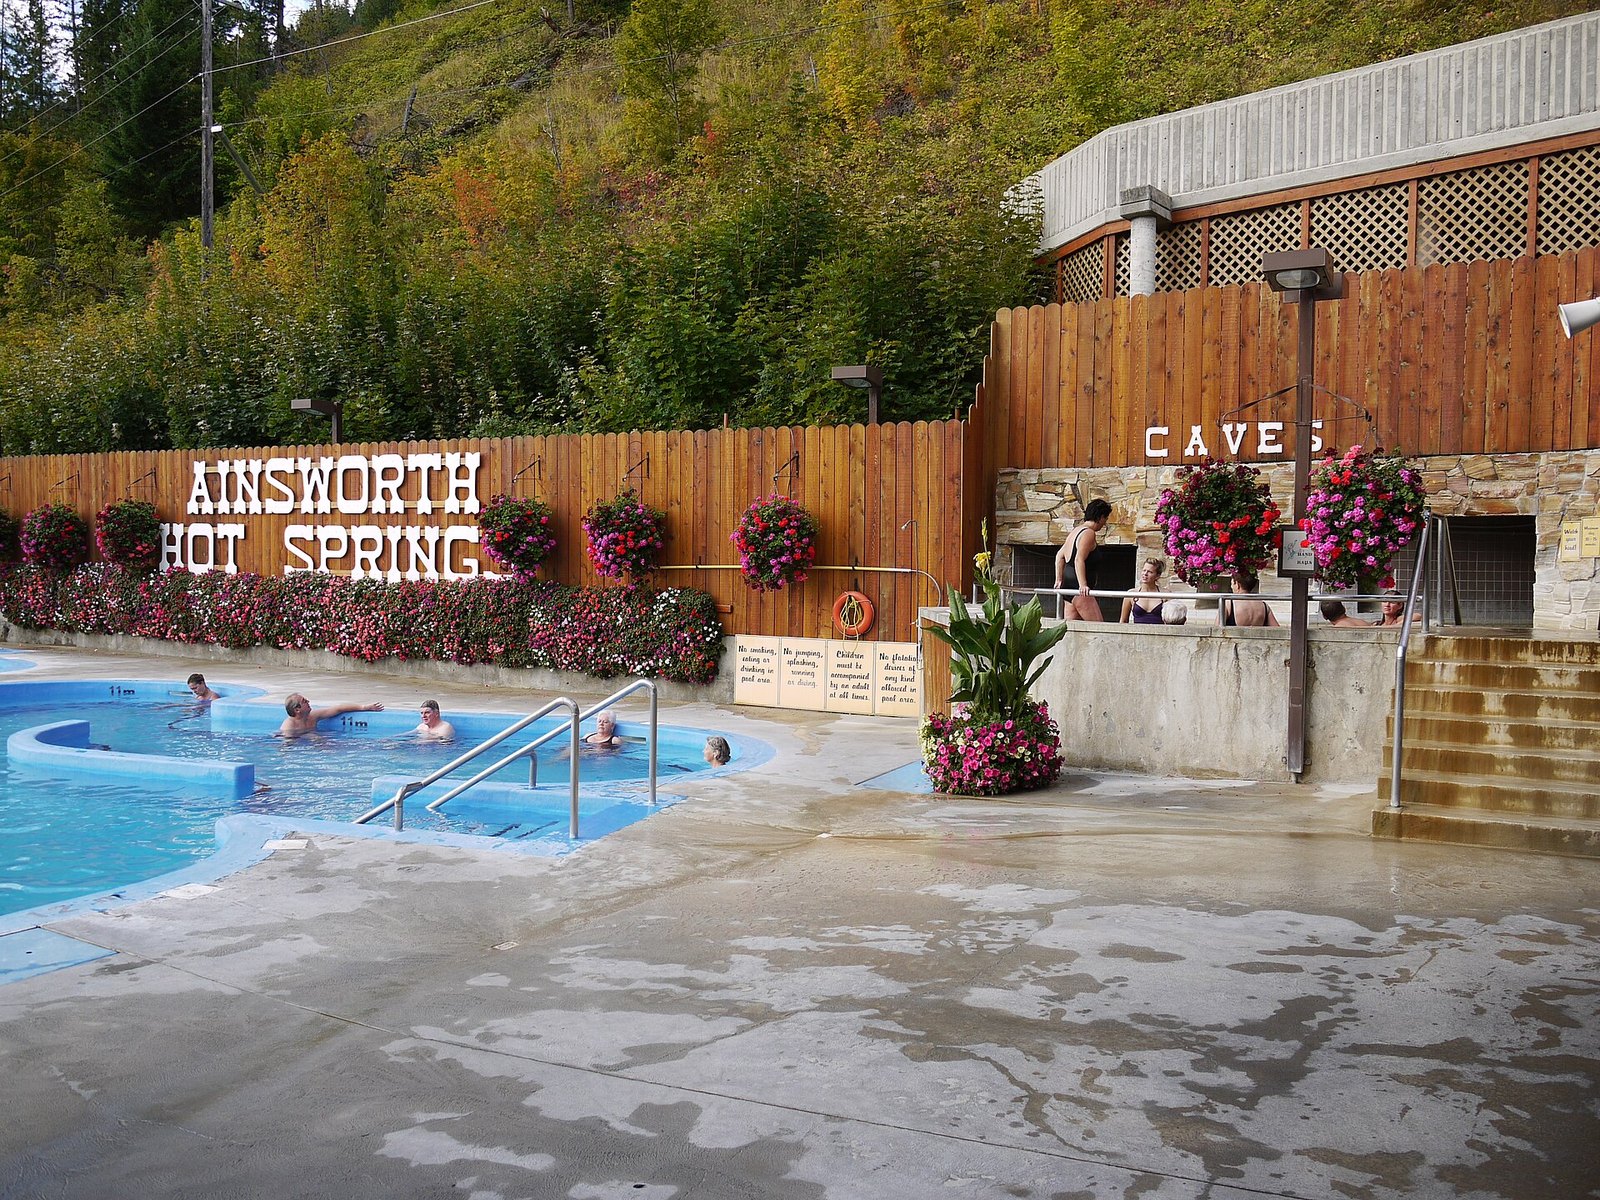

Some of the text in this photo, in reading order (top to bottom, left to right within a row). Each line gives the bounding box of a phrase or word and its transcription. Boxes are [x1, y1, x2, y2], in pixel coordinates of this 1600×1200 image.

[187, 452, 481, 515] AINSWORTH
[159, 523, 514, 583] HOT SPRING
[738, 645, 777, 656] No smoking,
[836, 650, 864, 659] Children
[880, 652, 918, 664] No flotatio
